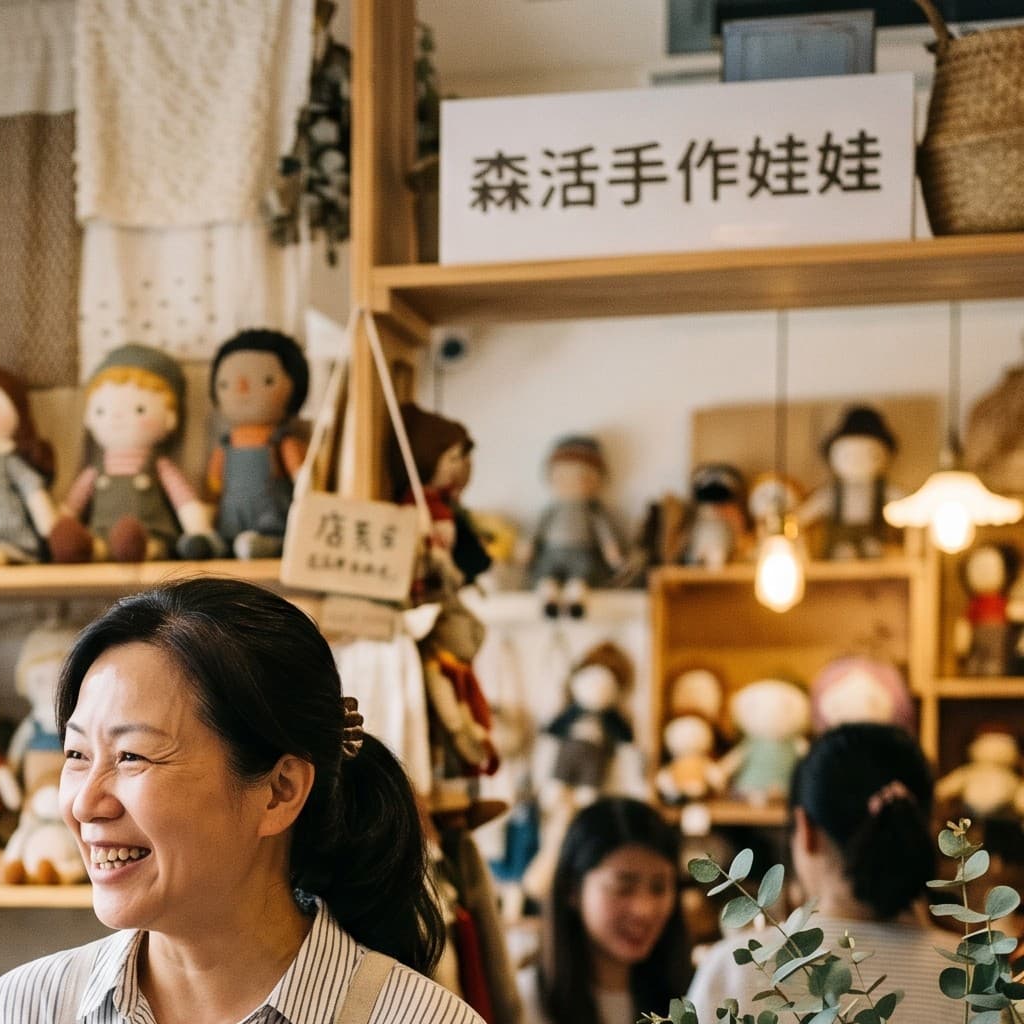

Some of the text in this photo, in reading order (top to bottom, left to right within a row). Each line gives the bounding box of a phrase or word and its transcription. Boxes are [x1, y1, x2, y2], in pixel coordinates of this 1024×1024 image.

[469, 129, 882, 213] 森活手作娃娃
